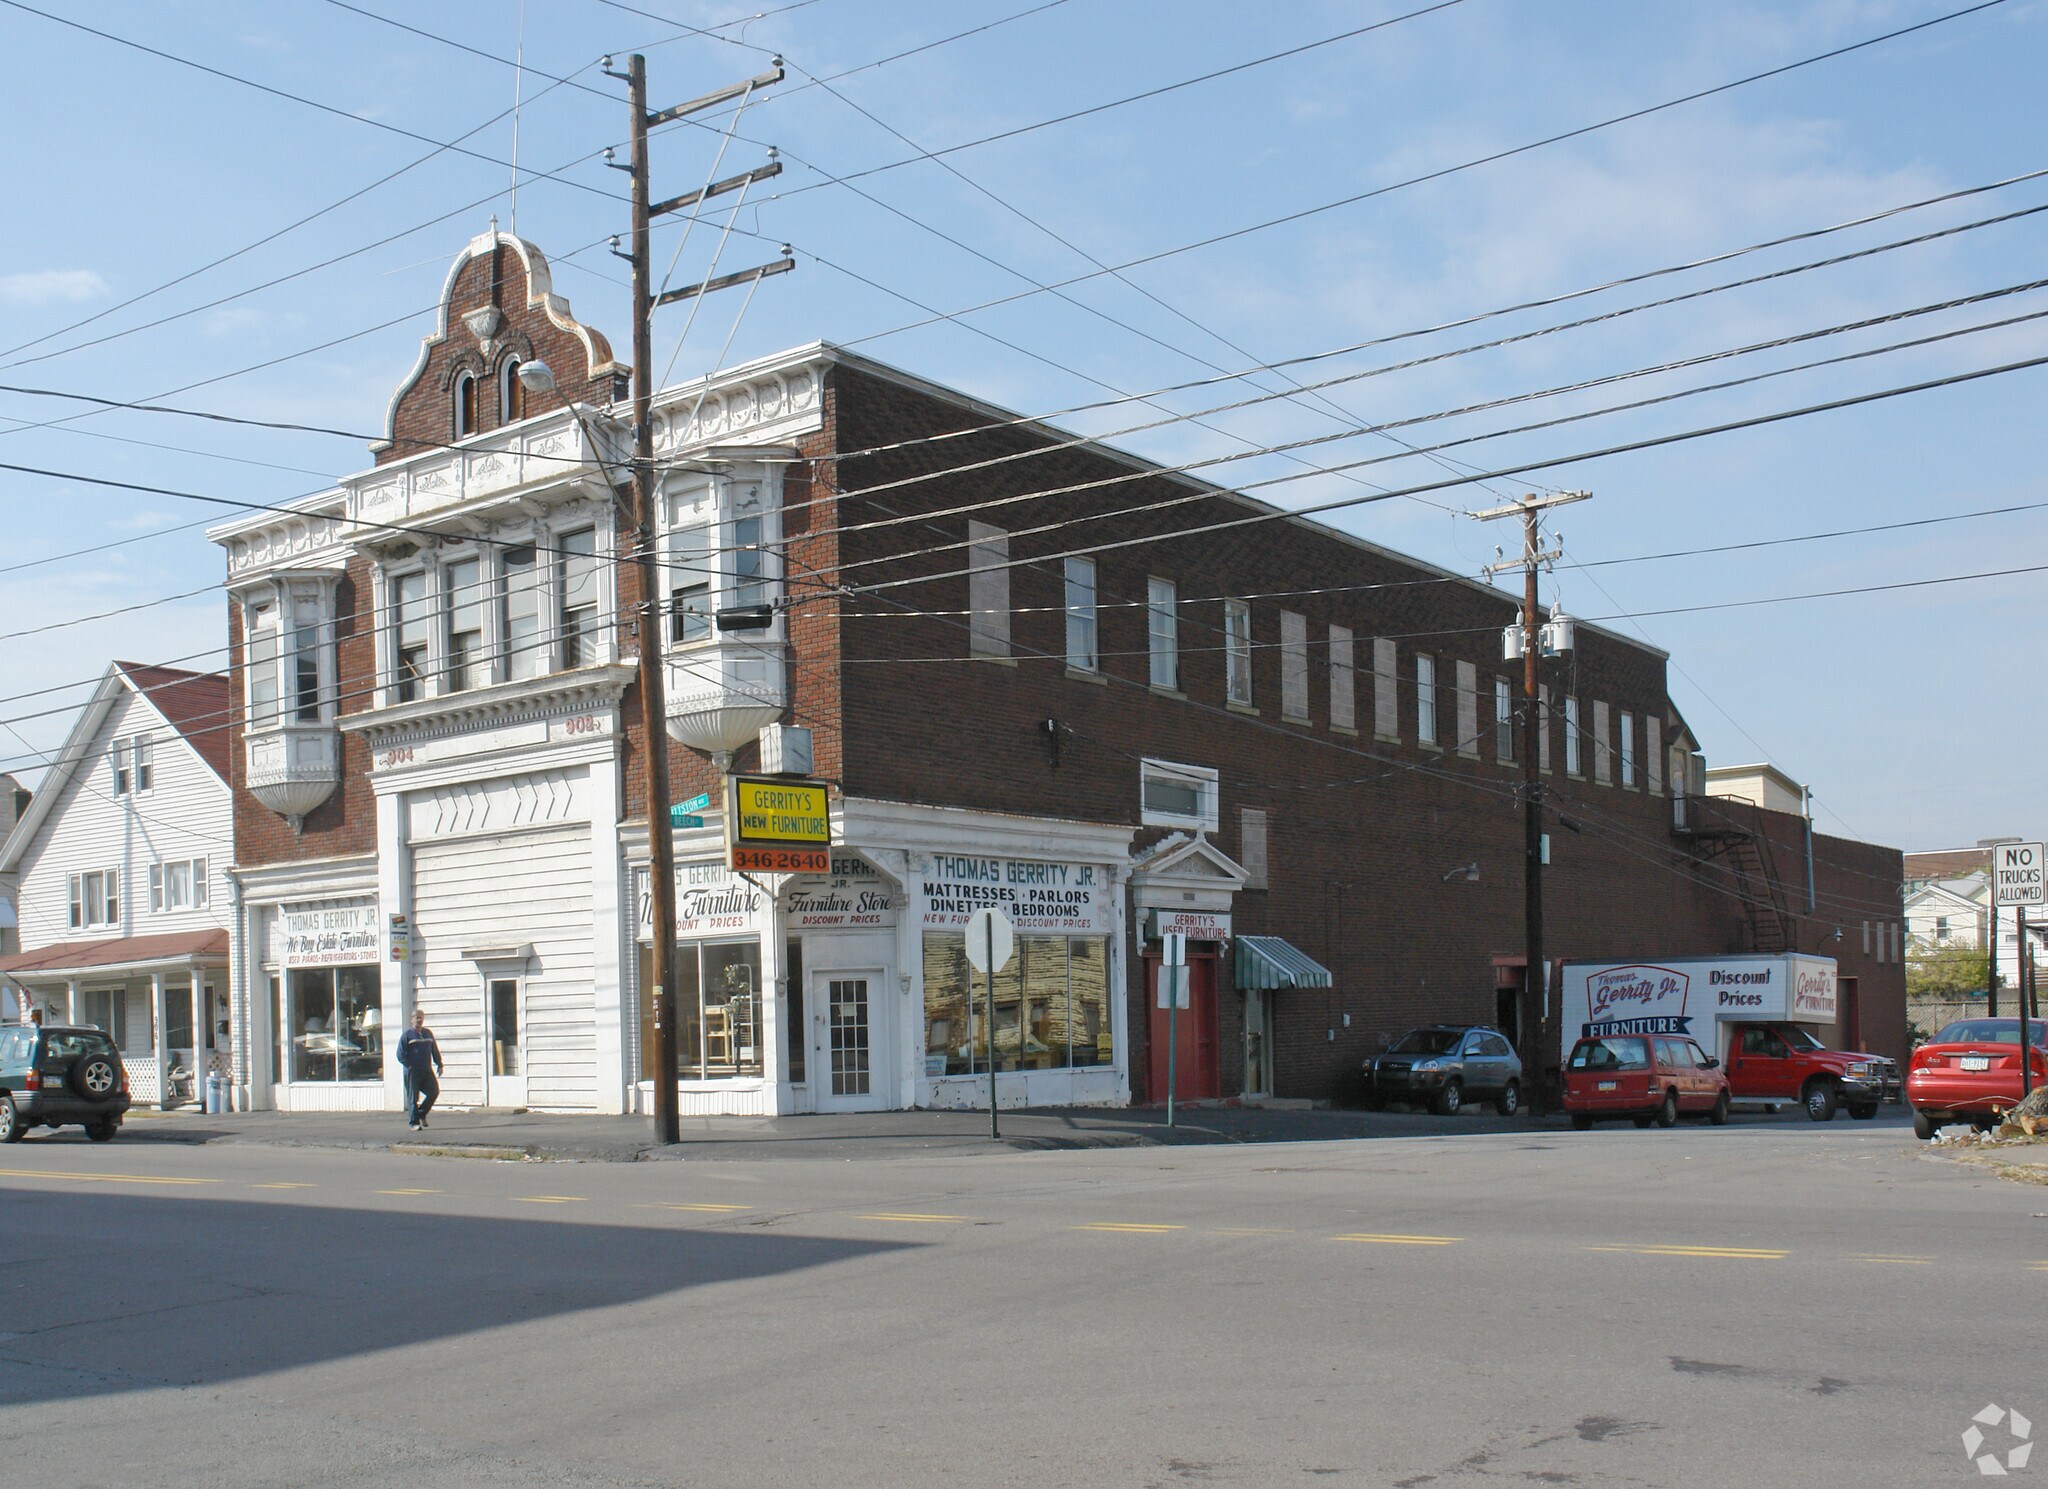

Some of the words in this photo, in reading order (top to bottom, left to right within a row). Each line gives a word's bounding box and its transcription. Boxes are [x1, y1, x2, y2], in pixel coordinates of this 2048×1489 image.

[565, 714, 594, 734] 902
[387, 746, 414, 765] 904
[754, 790, 812, 811] GERRITY'S
[674, 815, 695, 826] BEECH
[743, 816, 767, 828] NEW
[772, 815, 826, 835] FURNITURE
[2006, 848, 2033, 866] NO
[934, 855, 999, 881] THOMAS
[1006, 861, 1068, 885] GERRITY
[1075, 865, 1096, 886] JR.
[1998, 868, 2041, 885] TRUCKS
[831, 879, 851, 888] JR.
[683, 884, 761, 919] Furniture
[923, 882, 1016, 901] MATTRESSES
[1029, 889, 1090, 904] PARLORS
[1998, 886, 2042, 901] ALLOWED
[788, 891, 853, 914] Furniture
[856, 891, 892, 914] Store
[1012, 903, 1079, 917] BEDROOMS
[287, 913, 319, 931] THOMAS
[324, 910, 360, 929] GERRITY
[365, 908, 378, 925] JR.
[710, 916, 744, 928] PRICES
[802, 915, 845, 924] DISCOUNT
[850, 914, 881, 924] PRICES
[923, 913, 946, 924] NEW
[1017, 917, 1059, 928] DISCOUNT
[1063, 918, 1091, 928] PRICES
[1175, 914, 1215, 927] GERRITY'S
[1185, 926, 1227, 939] FURNITURE
[286, 935, 299, 953] We
[300, 935, 315, 955] Buy
[316, 932, 338, 952] Estate
[340, 930, 377, 951] Furniture
[288, 955, 300, 964] USED
[1597, 972, 1638, 986] Thomas
[1709, 968, 1771, 985] Discount
[1592, 980, 1654, 1015] Gerrity
[1657, 977, 1680, 1000] Jr.
[1718, 990, 1762, 1006] Prices
[1805, 996, 1834, 1011] FURNITURE
[1589, 1017, 1678, 1038] FURNITURE
